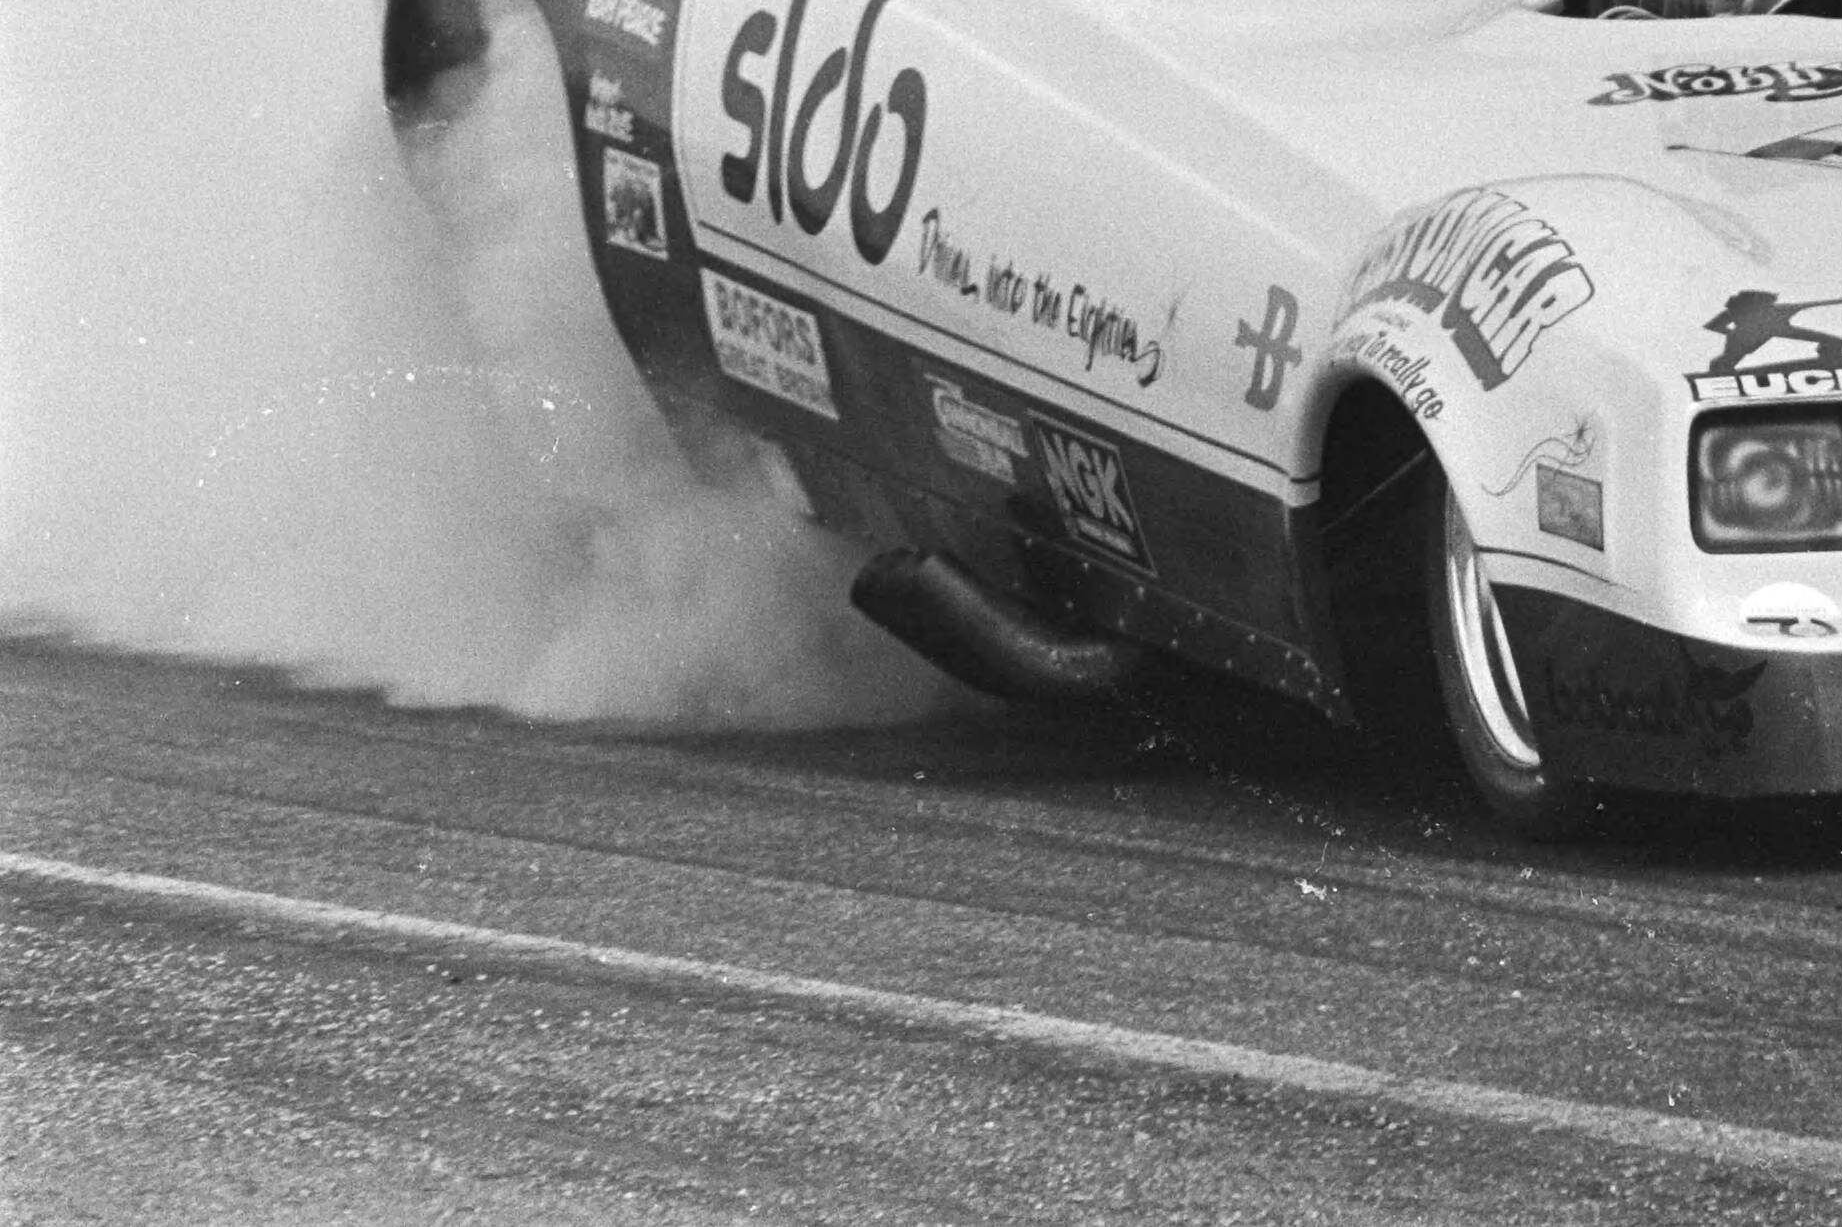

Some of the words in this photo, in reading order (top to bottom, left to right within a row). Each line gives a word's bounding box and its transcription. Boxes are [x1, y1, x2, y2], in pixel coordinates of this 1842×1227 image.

[1442, 219, 1595, 392] CAR
[1376, 341, 1431, 402] really
[1411, 385, 1446, 422] go
[1035, 427, 1136, 534] NGK
